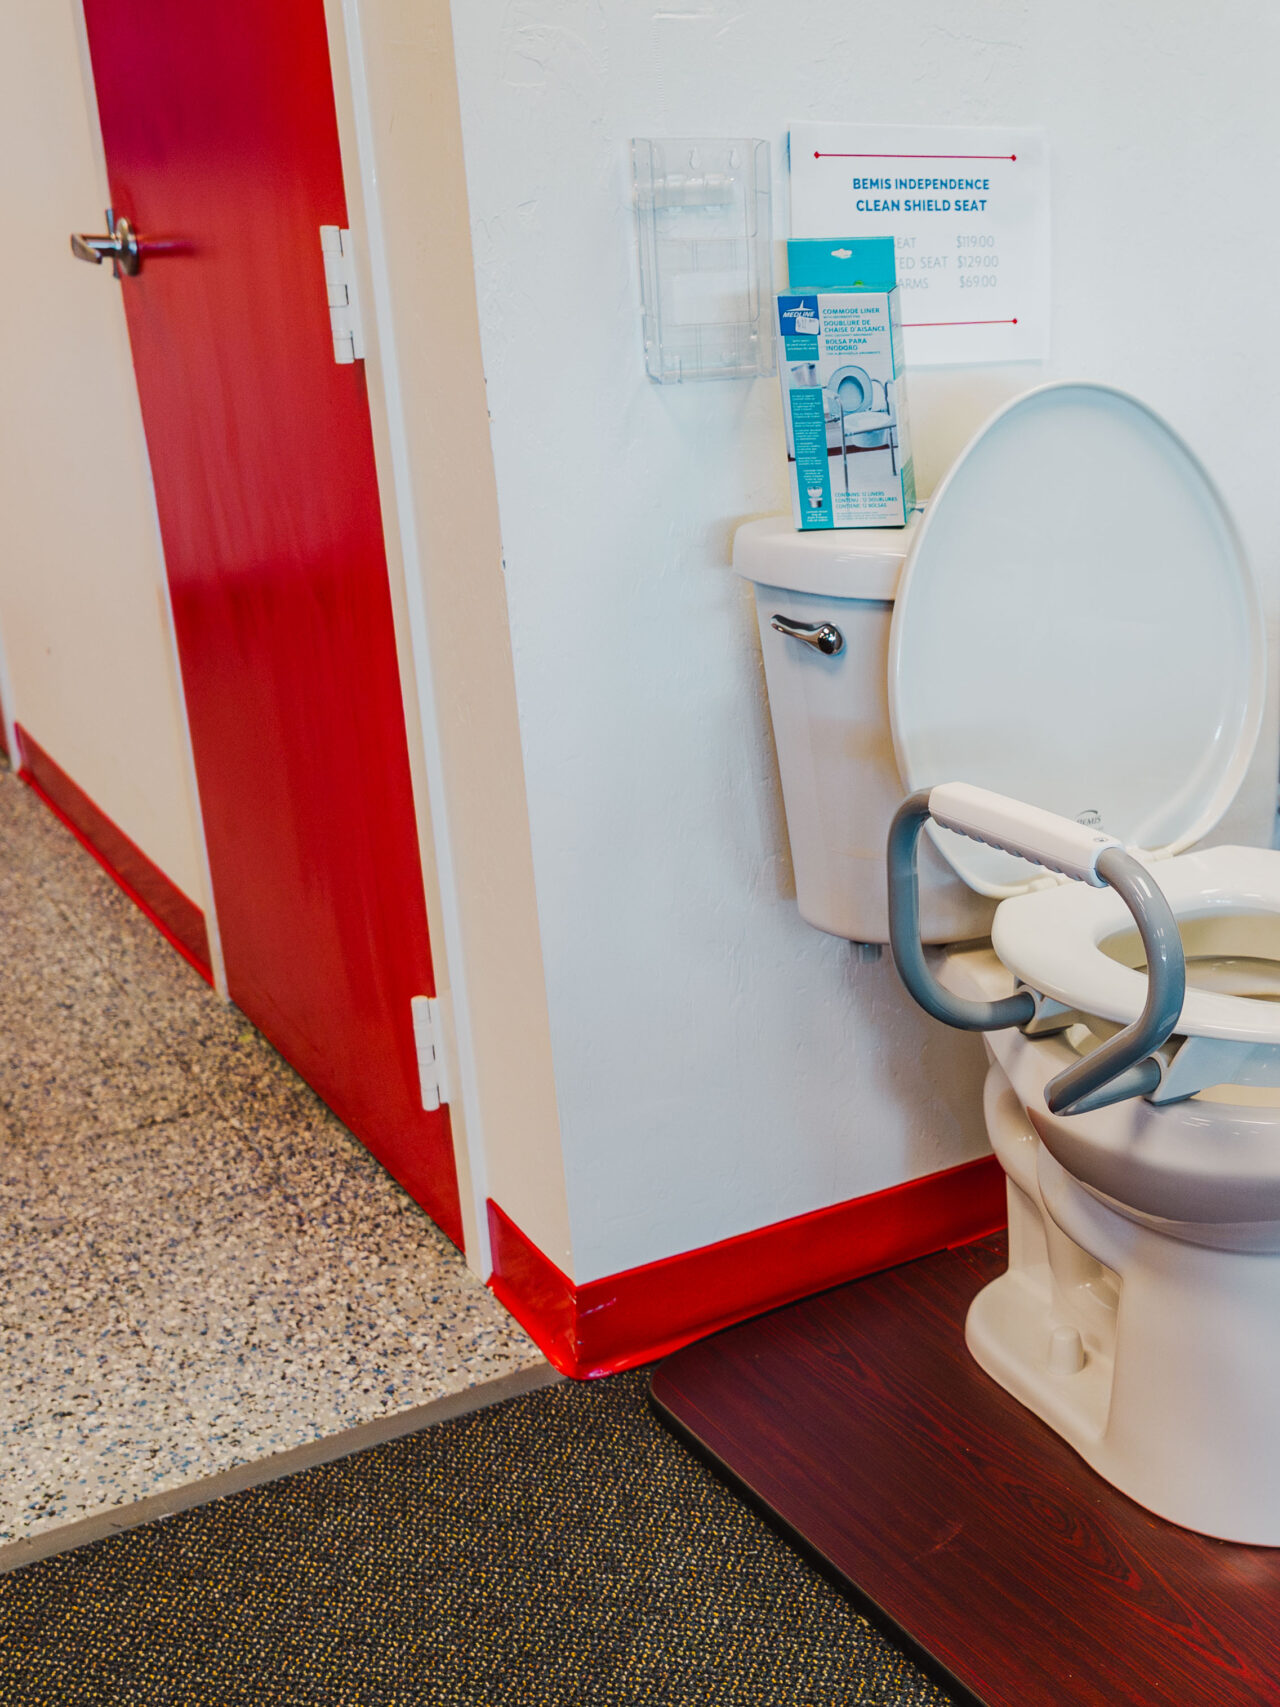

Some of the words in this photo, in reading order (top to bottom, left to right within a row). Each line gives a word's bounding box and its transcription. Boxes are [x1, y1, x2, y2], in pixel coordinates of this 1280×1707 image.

[853, 178, 892, 190] BEMIS
[895, 178, 990, 190] INDEPENDENCE
[856, 199, 900, 212] CLEAN
[904, 199, 951, 212] SHIELD
[954, 199, 987, 212] SEAT
[895, 237, 917, 249] EAT
[920, 256, 948, 269] SEAT
